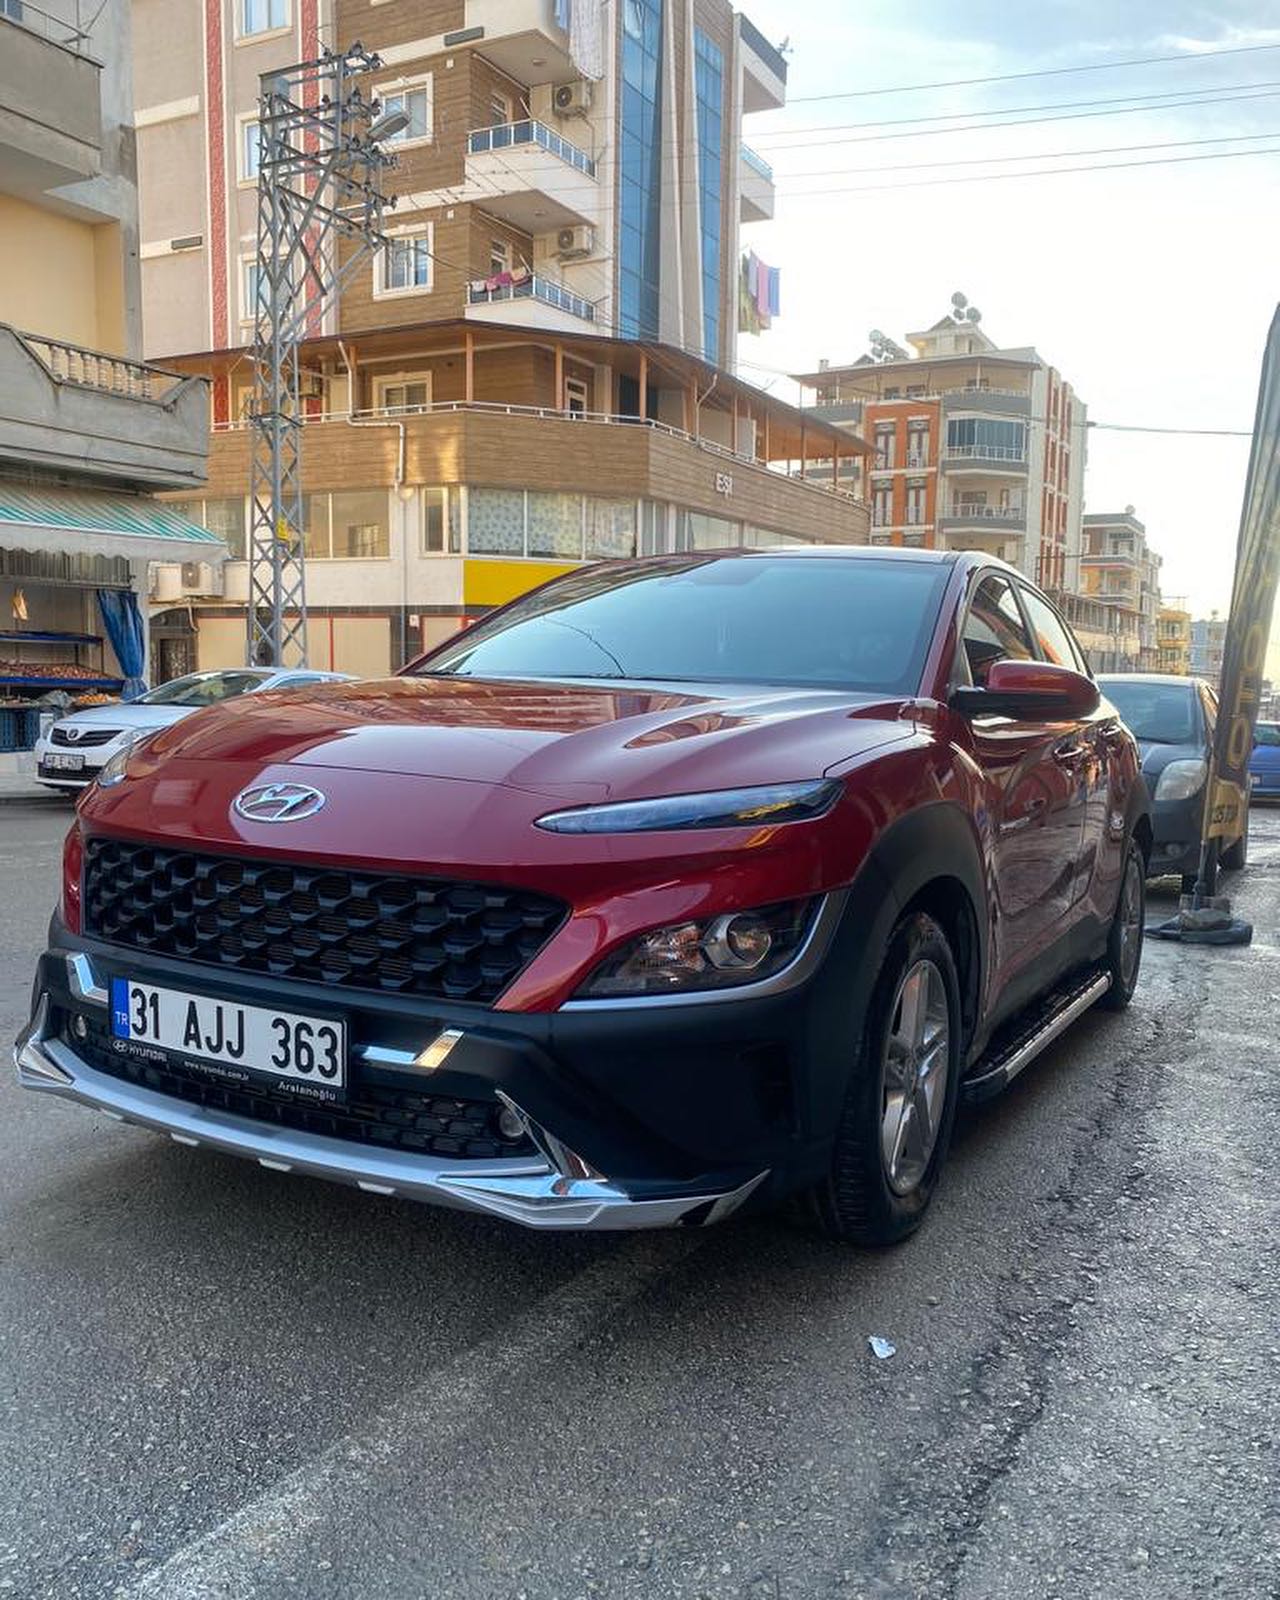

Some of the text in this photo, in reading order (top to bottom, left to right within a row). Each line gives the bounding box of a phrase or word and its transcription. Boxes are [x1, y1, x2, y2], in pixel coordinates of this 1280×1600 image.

[114, 1010, 129, 1026] TR
[131, 987, 339, 1079] 31 AJJ 363
[128, 1044, 168, 1063] HYUNDAI
[278, 1081, 337, 1101] Arslanoğlu
